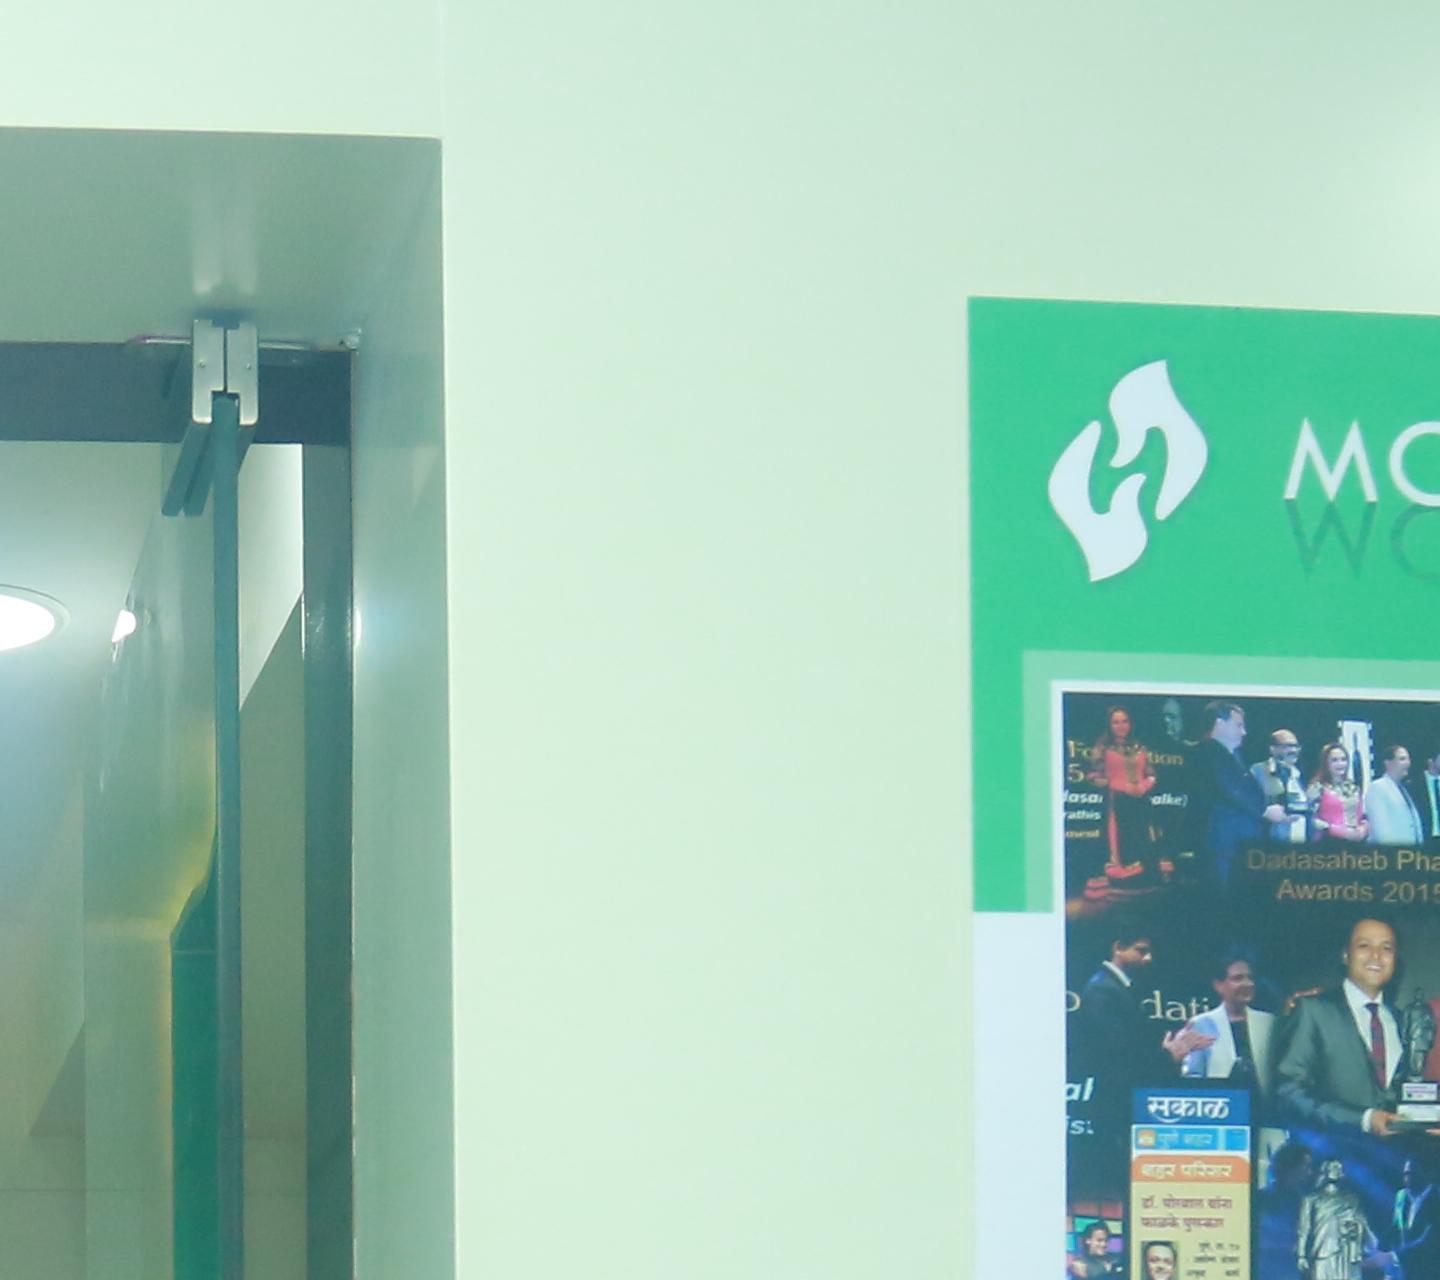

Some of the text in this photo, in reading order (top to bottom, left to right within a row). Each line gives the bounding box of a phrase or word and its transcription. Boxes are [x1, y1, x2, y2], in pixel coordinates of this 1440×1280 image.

[1248, 849, 1388, 870] Dadasaheb
[1277, 879, 1373, 901] Awards
[1147, 1096, 1231, 1123] सकाळ
